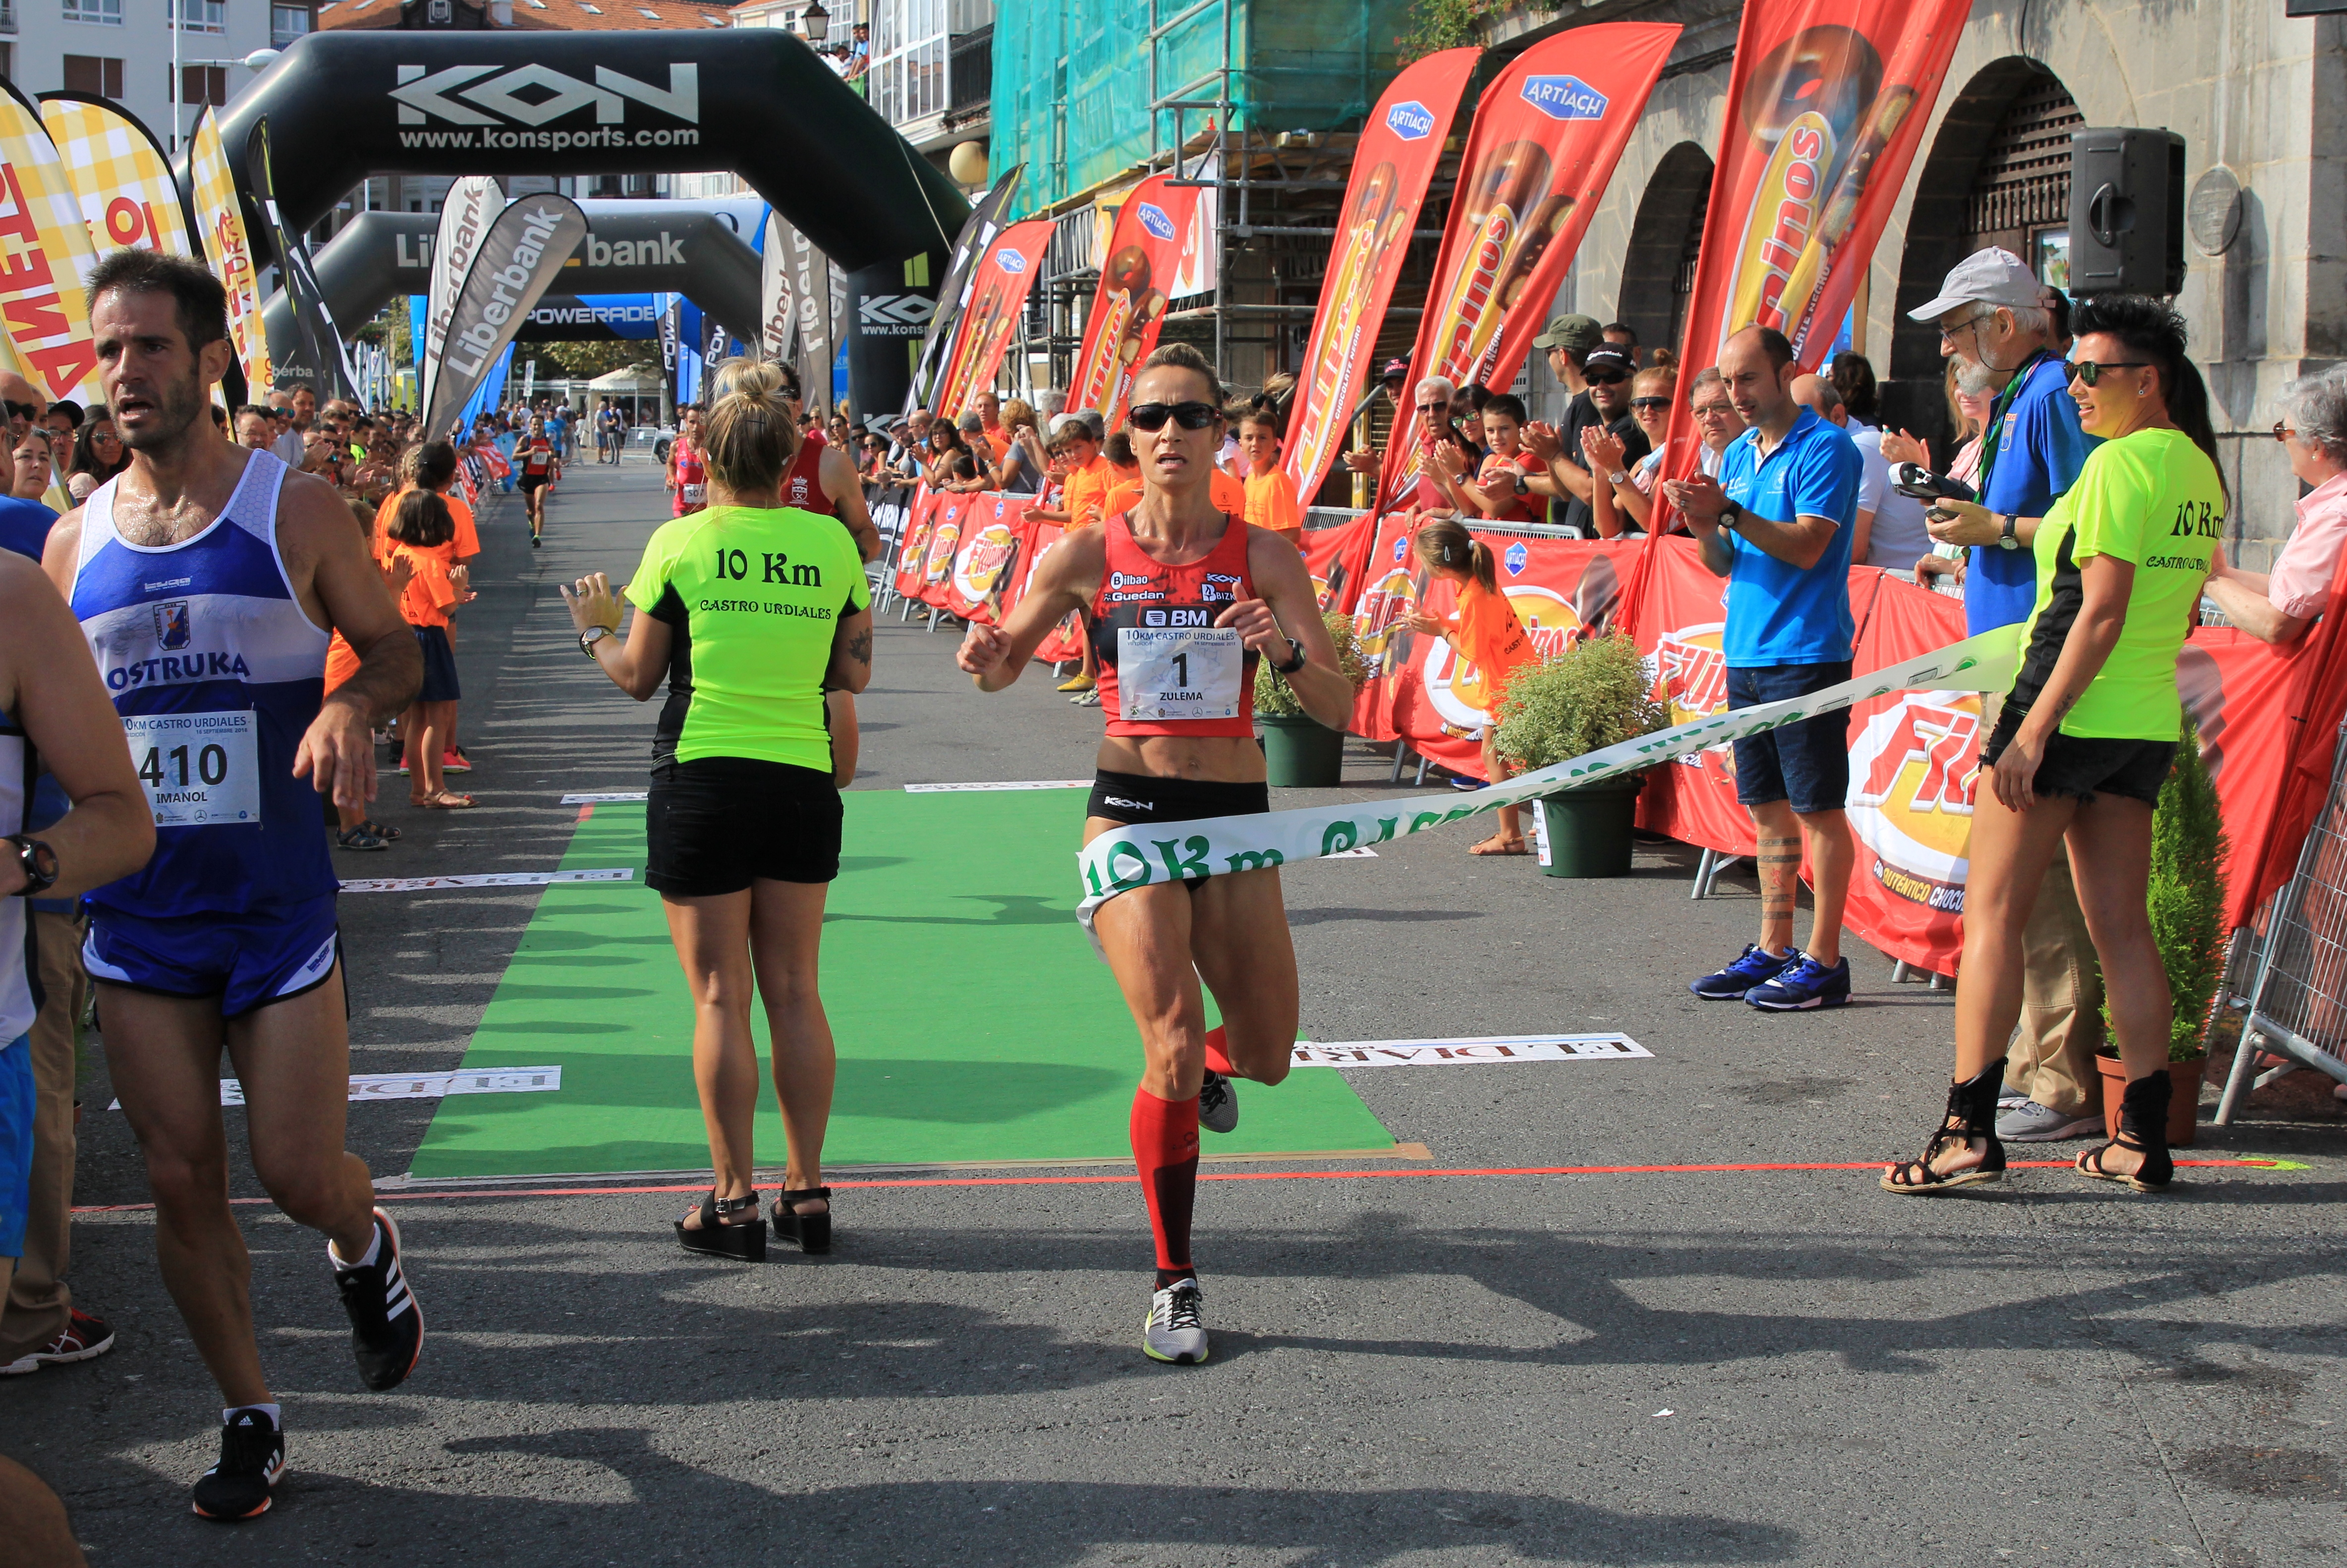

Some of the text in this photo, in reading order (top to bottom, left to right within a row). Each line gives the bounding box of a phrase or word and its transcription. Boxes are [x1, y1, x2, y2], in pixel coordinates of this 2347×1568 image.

[388, 63, 699, 127] KON
[1526, 81, 1602, 115] ARTIACH
[1389, 107, 1431, 134] ARTIACH
[399, 126, 699, 151] www.konsports.com
[1140, 209, 1174, 240] ARTIACH
[997, 252, 1025, 271] ARTIACH
[447, 206, 563, 378] Liberbank
[527, 305, 655, 325] POWERADE
[858, 294, 937, 323] KO
[1335, 363, 1354, 420] CHOCOLATE
[1349, 324, 1362, 361] NEGRO
[2170, 500, 2194, 536] 10
[716, 548, 822, 588] 10 Km
[1506, 553, 1526, 566] ARTIACH
[1110, 571, 1148, 590] Bilbao
[1206, 573, 1242, 584] KON
[1112, 590, 1165, 602] Guedan
[700, 599, 832, 620] CASTRO URDIALES
[1170, 610, 1208, 626] BM
[1125, 630, 1154, 640] 10KM
[1194, 632, 1234, 641] URDIALES
[107, 651, 251, 690] OSTRUKA
[1172, 653, 1188, 687] 1
[1160, 692, 1203, 701] ZULEMA
[149, 719, 192, 729] CASTRO
[194, 716, 247, 728] URDIALES
[139, 743, 228, 788] 410
[157, 791, 208, 804] IMANOL
[1104, 796, 1153, 811] KON
[1883, 867, 1931, 903] AUTÉNTICO
